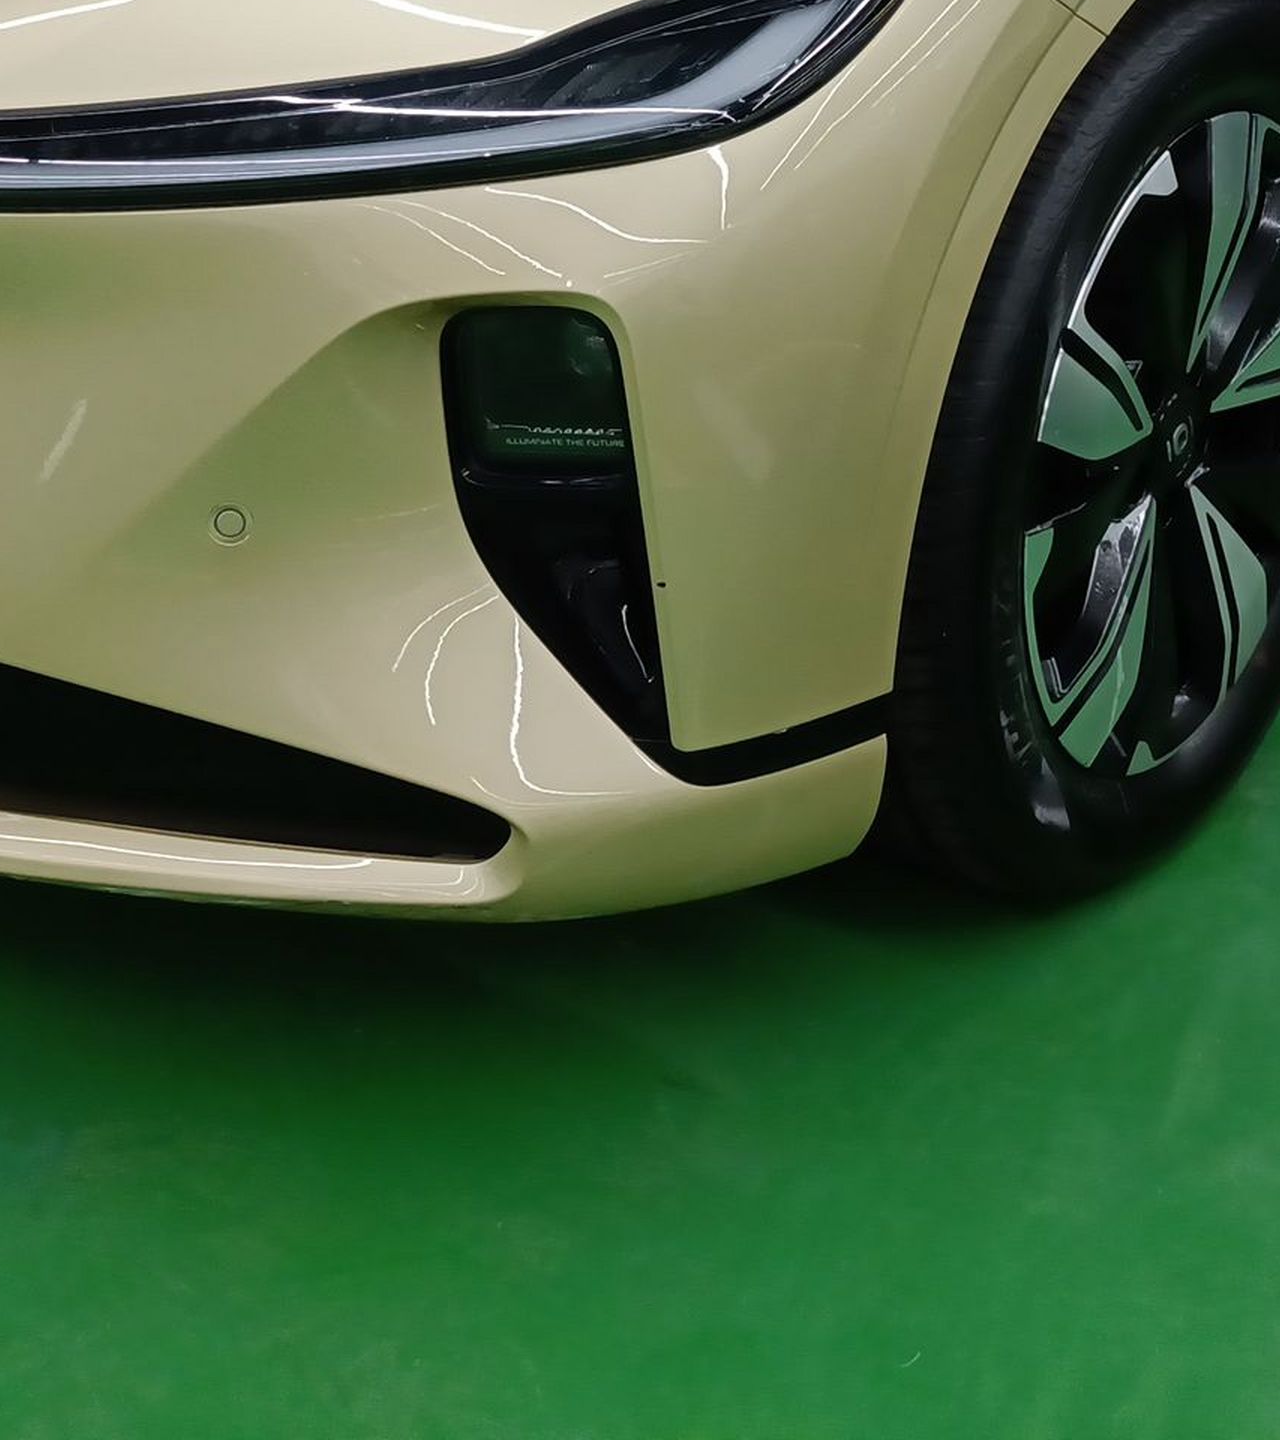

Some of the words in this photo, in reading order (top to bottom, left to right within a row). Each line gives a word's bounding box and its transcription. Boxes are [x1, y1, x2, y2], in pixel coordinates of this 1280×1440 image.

[505, 437, 562, 446] ILLUMINATE
[566, 438, 584, 447] THE
[586, 438, 625, 448] FUTURE
